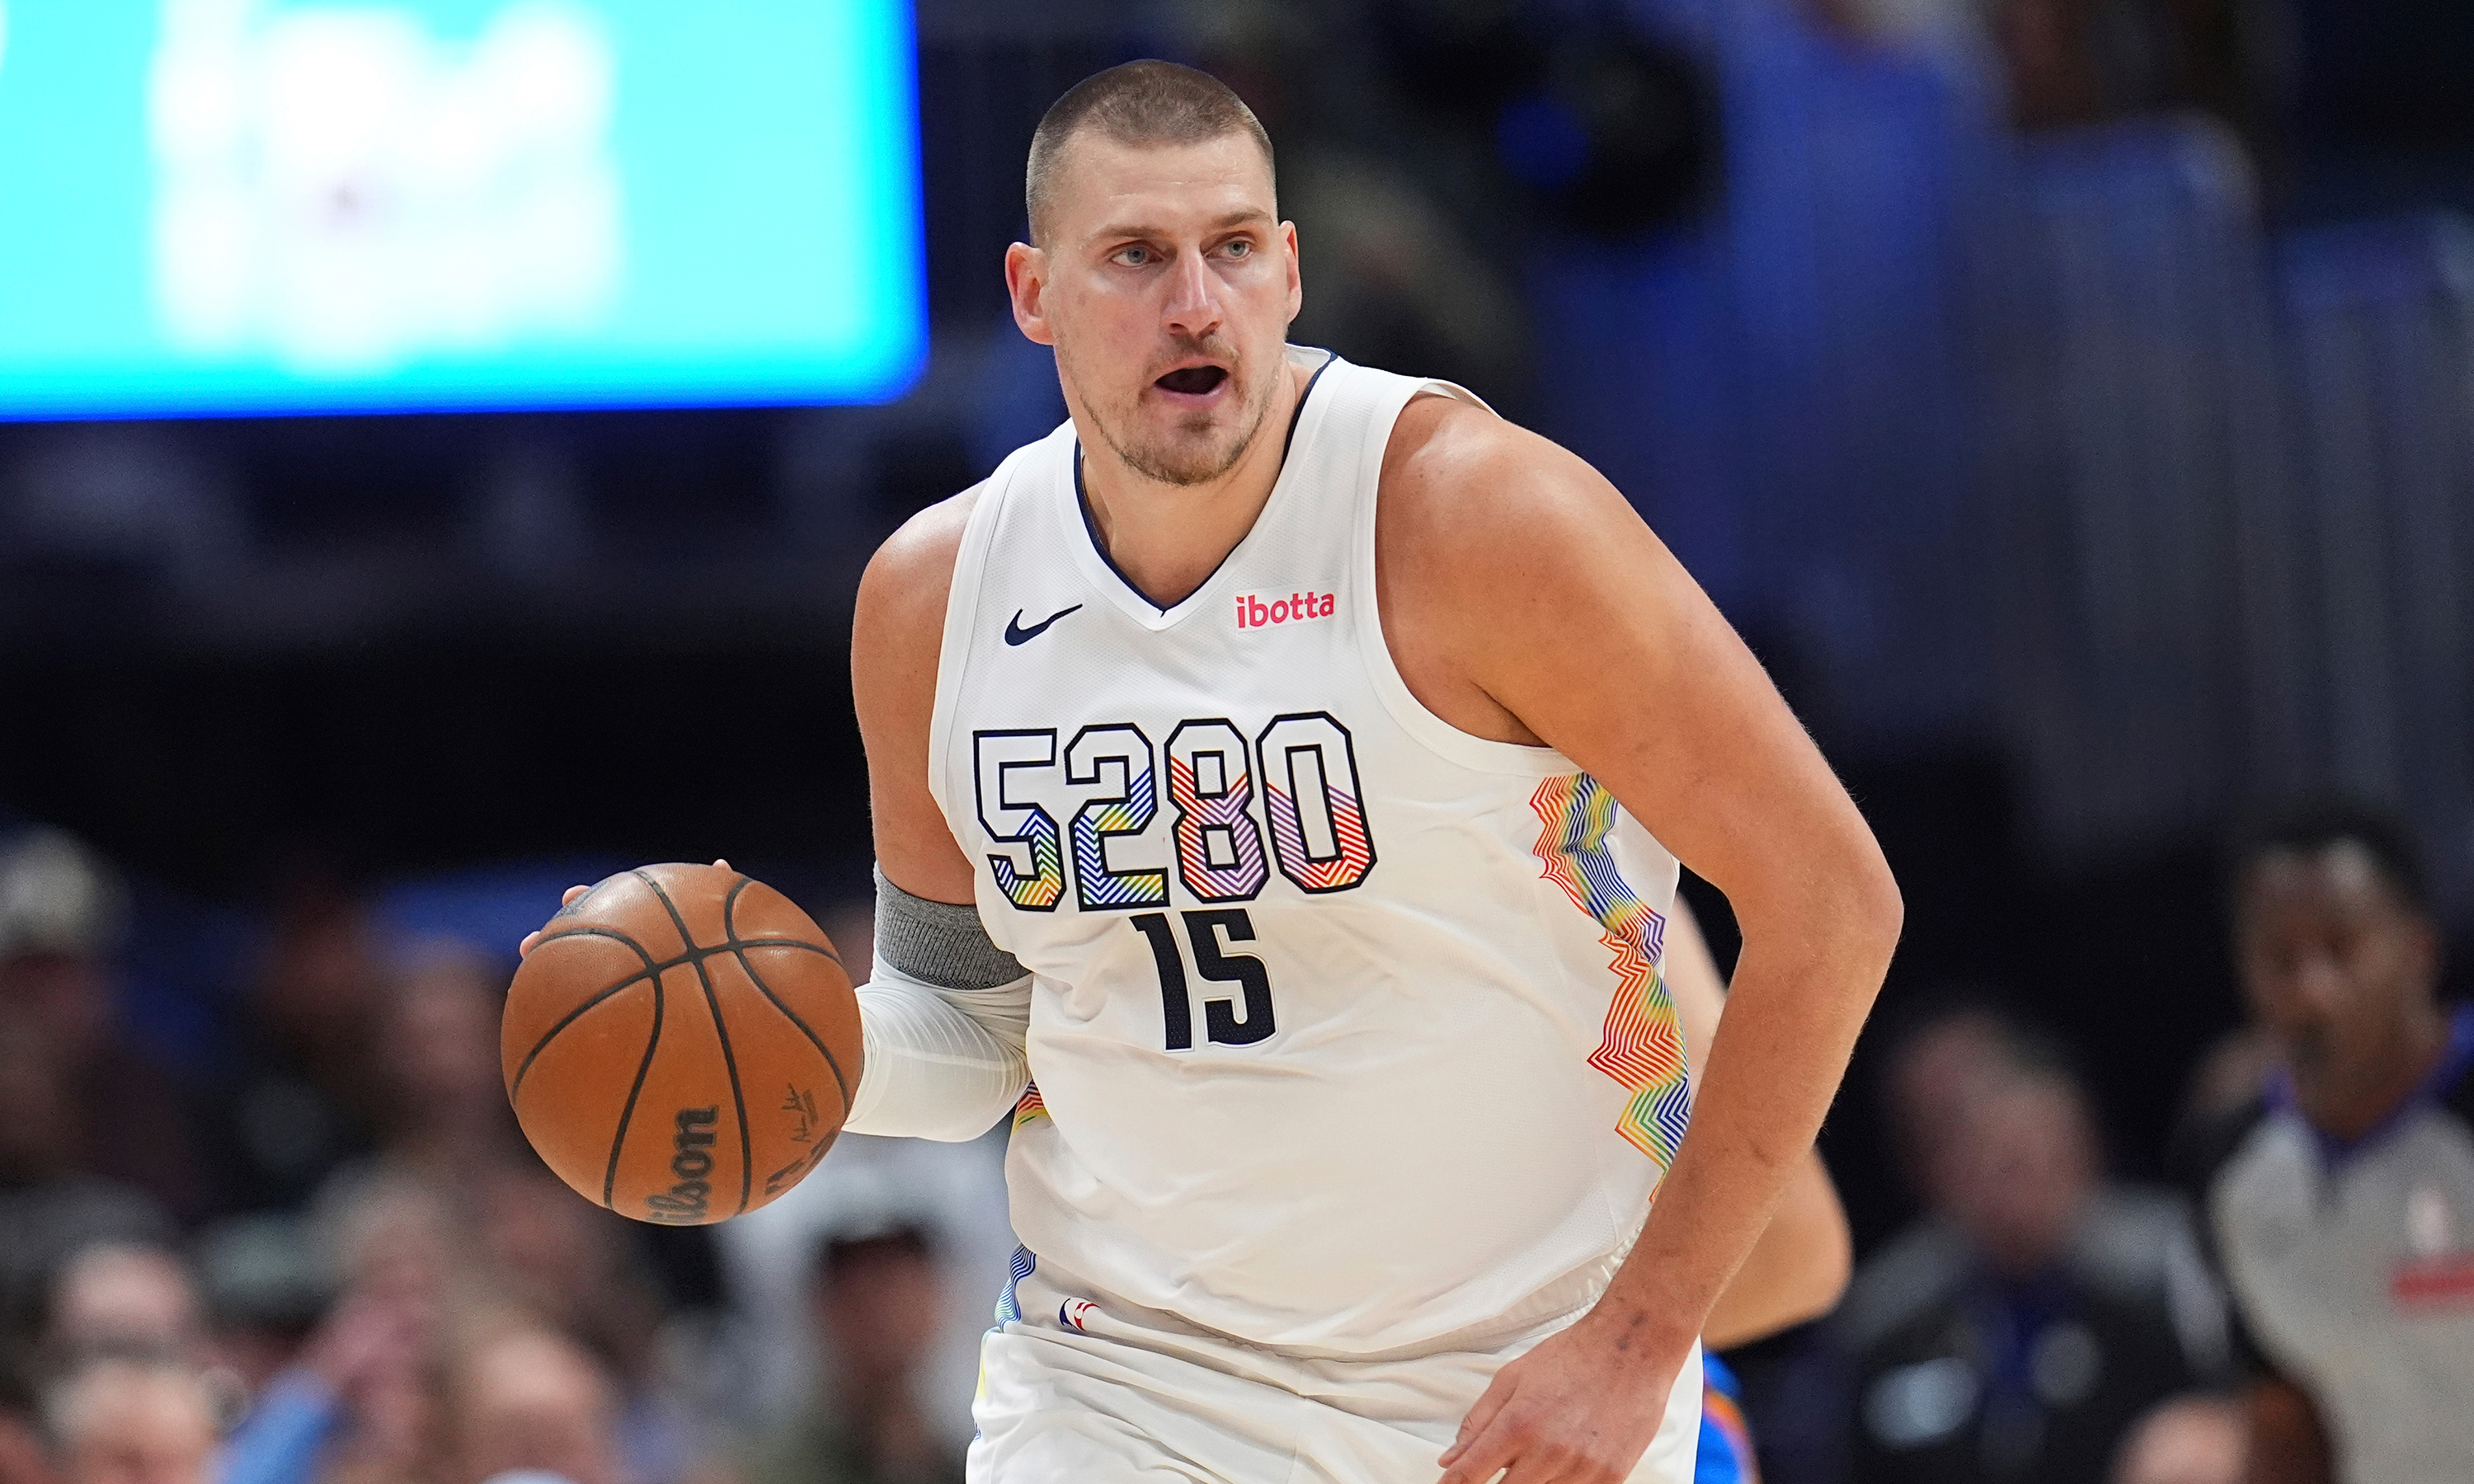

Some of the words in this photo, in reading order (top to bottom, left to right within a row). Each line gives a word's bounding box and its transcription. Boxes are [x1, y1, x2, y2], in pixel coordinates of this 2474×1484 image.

[1236, 591, 1334, 628] ibotta
[972, 711, 1377, 913] 5280
[1130, 909, 1278, 1051] 15
[645, 1104, 720, 1224] ilson
